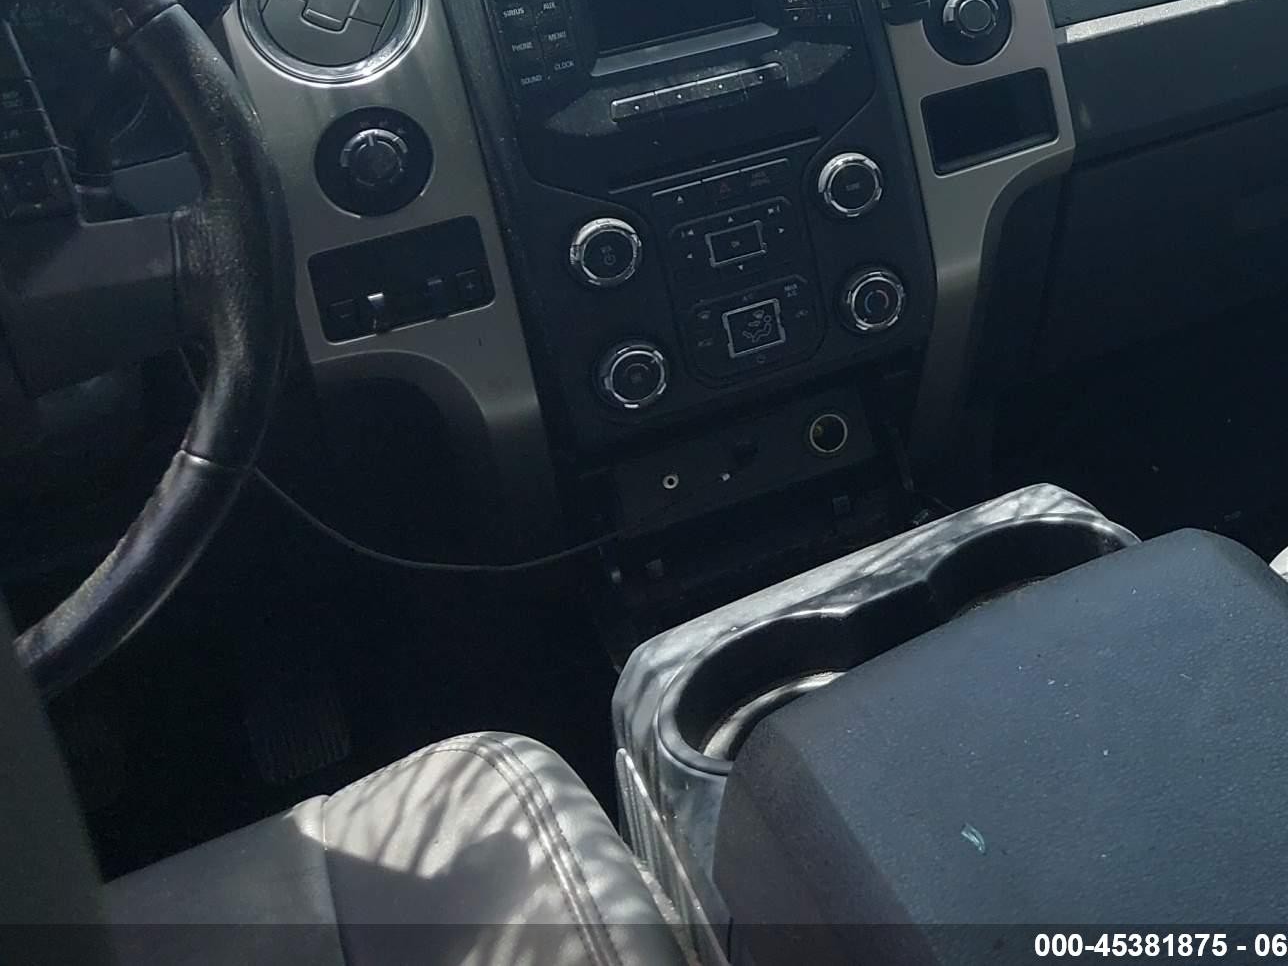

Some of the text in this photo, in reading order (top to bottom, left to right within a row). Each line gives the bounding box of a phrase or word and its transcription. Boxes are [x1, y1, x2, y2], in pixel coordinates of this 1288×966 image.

[543, 1, 556, 11] AUX
[503, 7, 525, 18] SIRIUS
[554, 60, 575, 71] CLOCK
